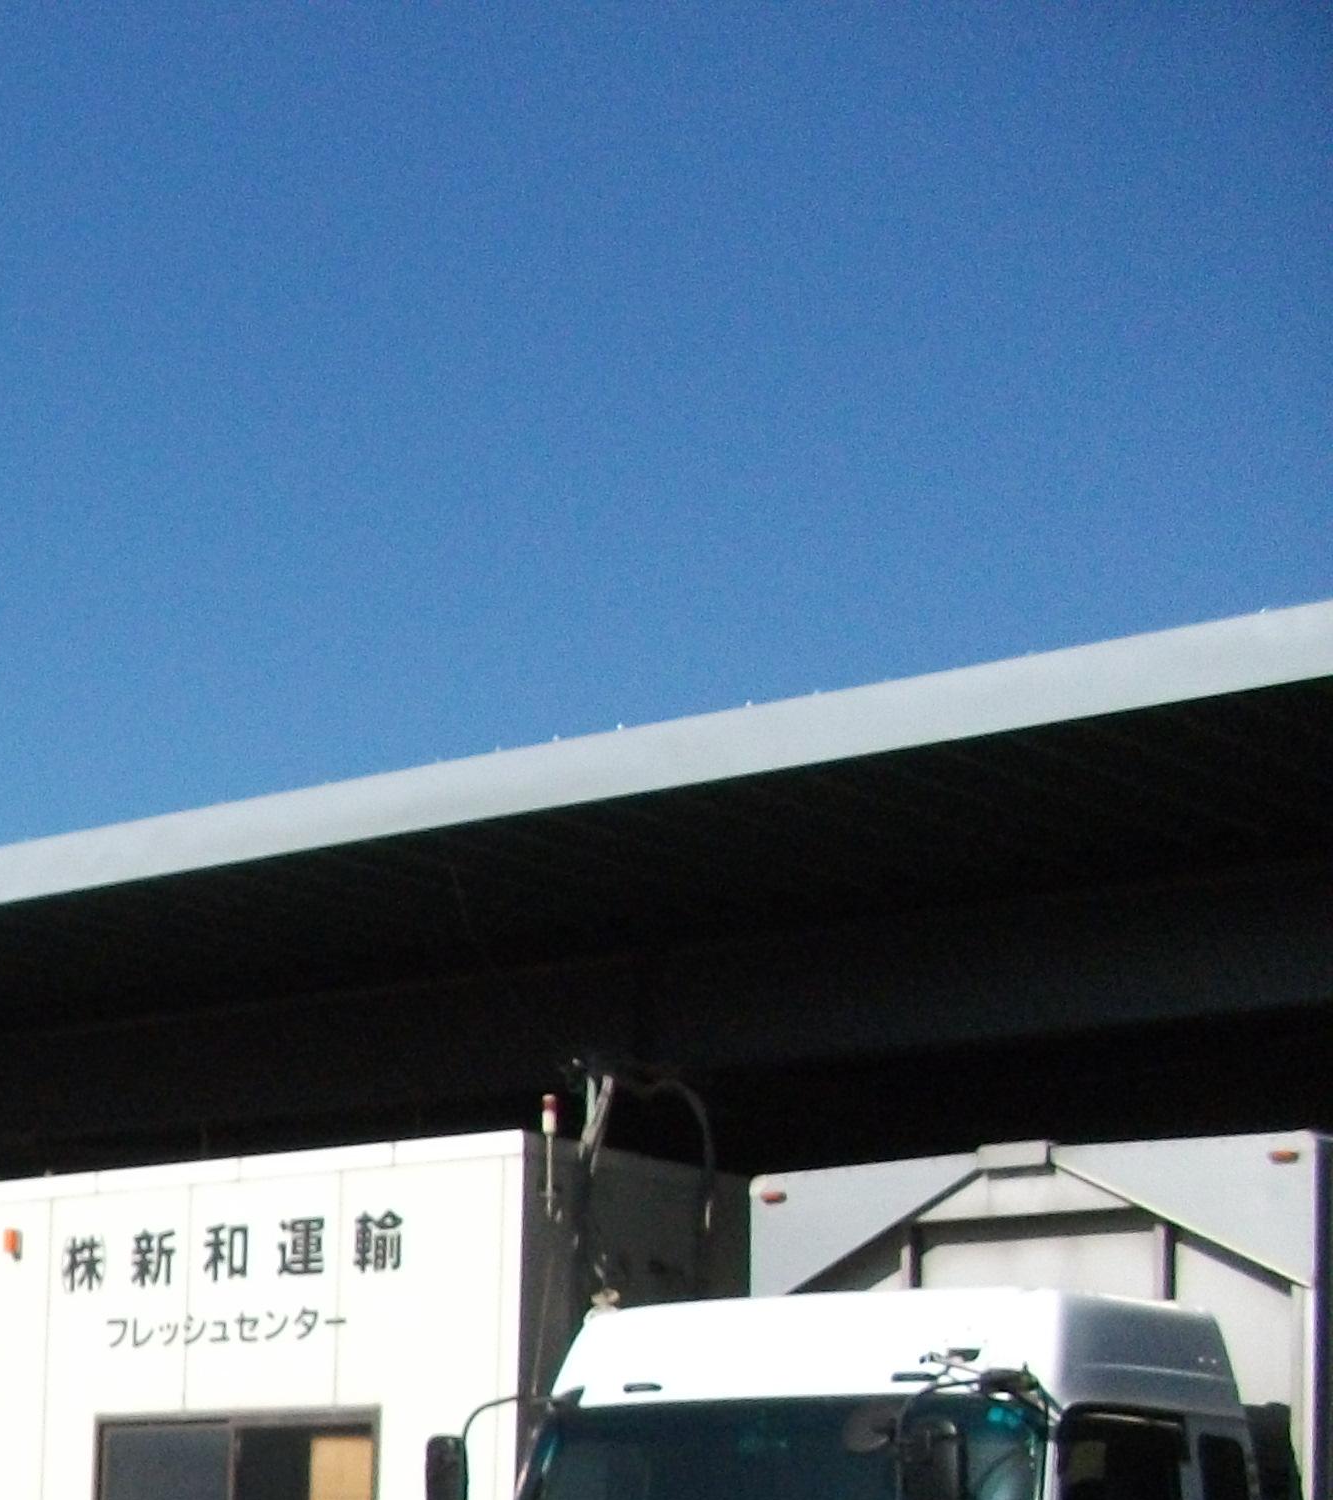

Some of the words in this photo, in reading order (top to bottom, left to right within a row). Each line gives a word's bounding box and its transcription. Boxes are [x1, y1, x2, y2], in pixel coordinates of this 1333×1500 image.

[106, 1306, 347, 1349] フレッシュセンター
